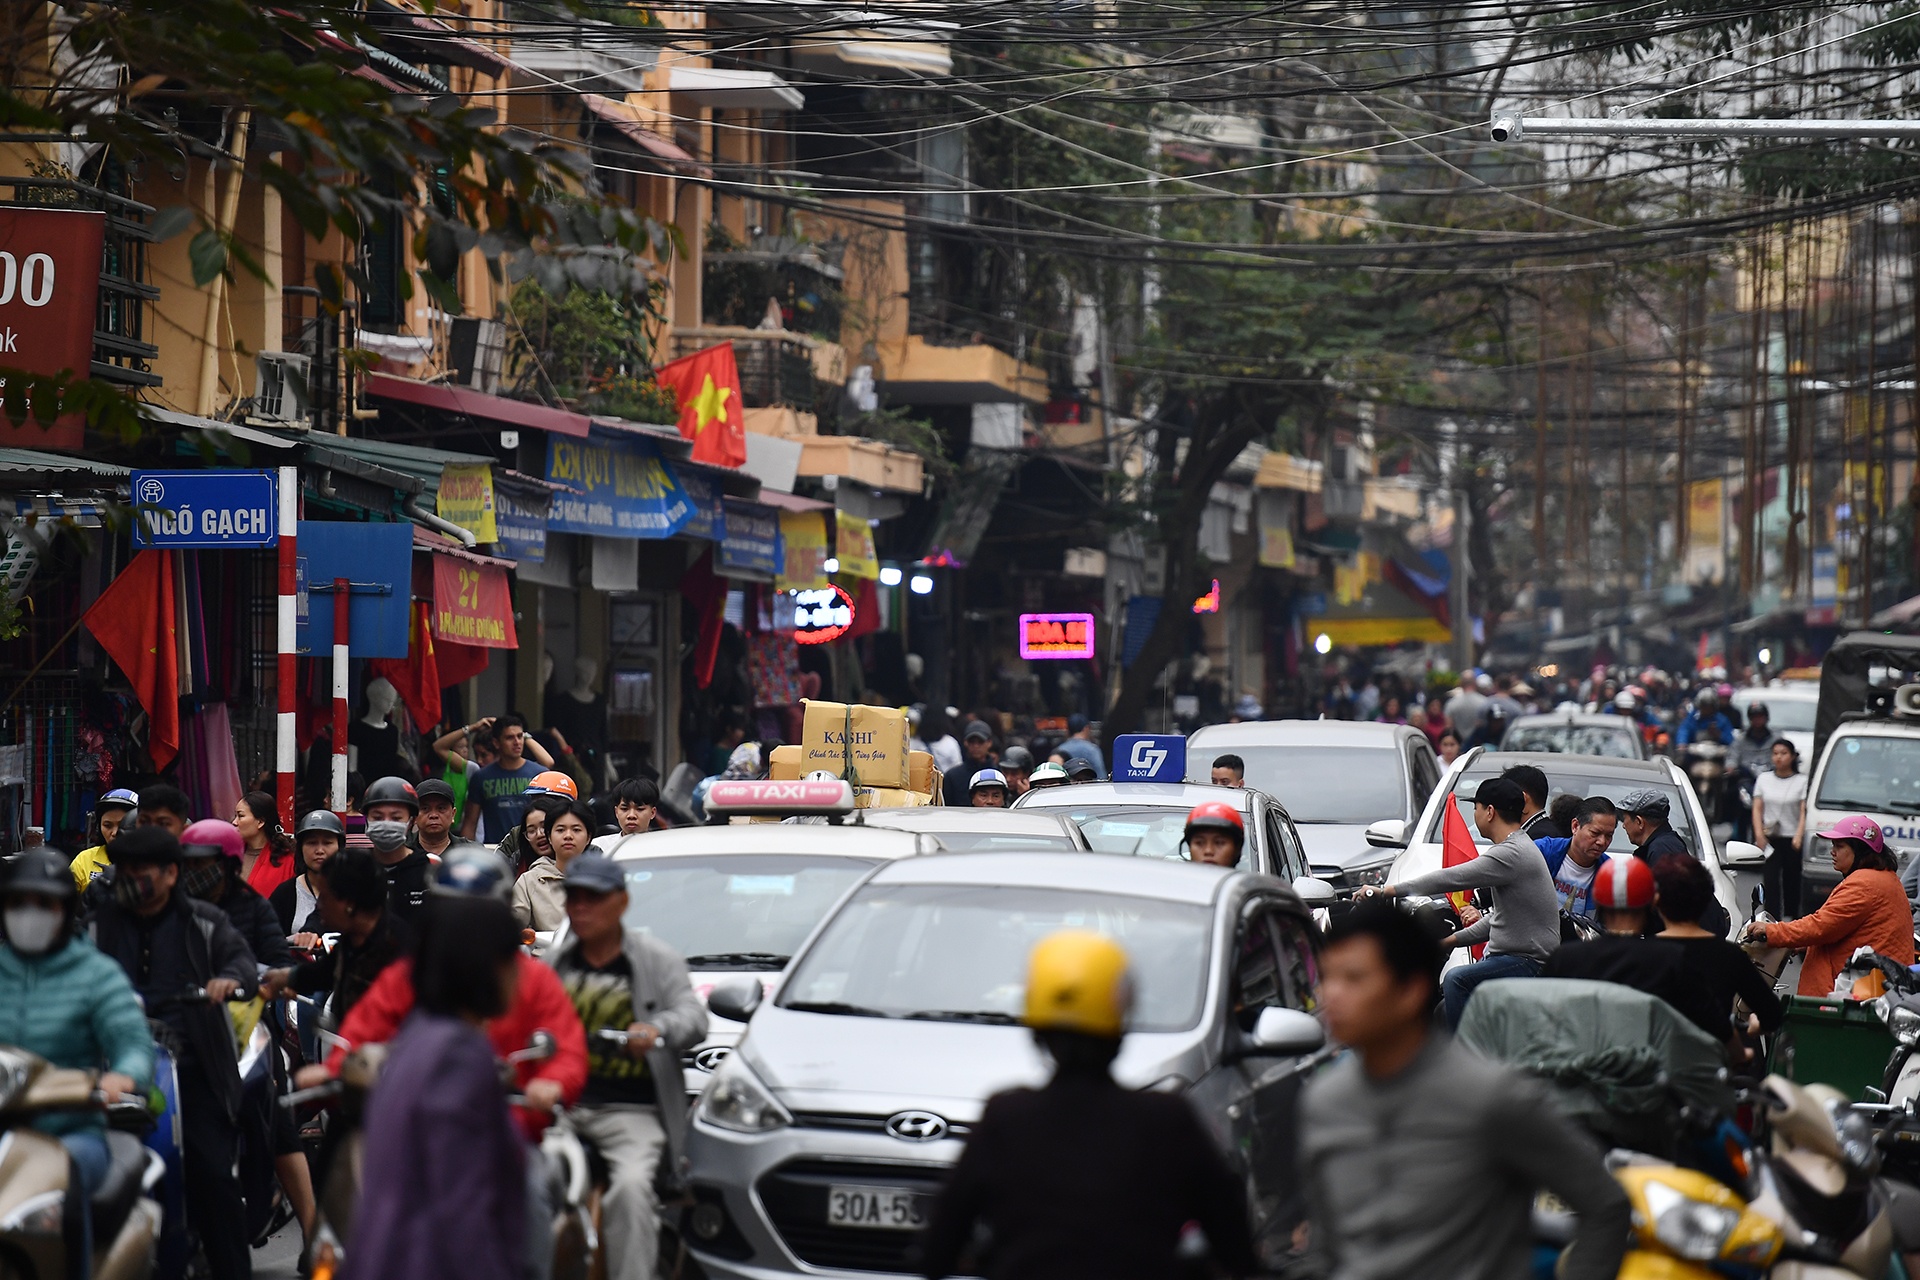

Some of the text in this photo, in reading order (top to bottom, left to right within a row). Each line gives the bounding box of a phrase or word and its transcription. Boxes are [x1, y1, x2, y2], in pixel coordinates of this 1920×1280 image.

[201, 508, 266, 539] GẠCH
[1130, 740, 1168, 777] G7
[1127, 769, 1147, 777] TAXI
[750, 785, 806, 799] TAXI
